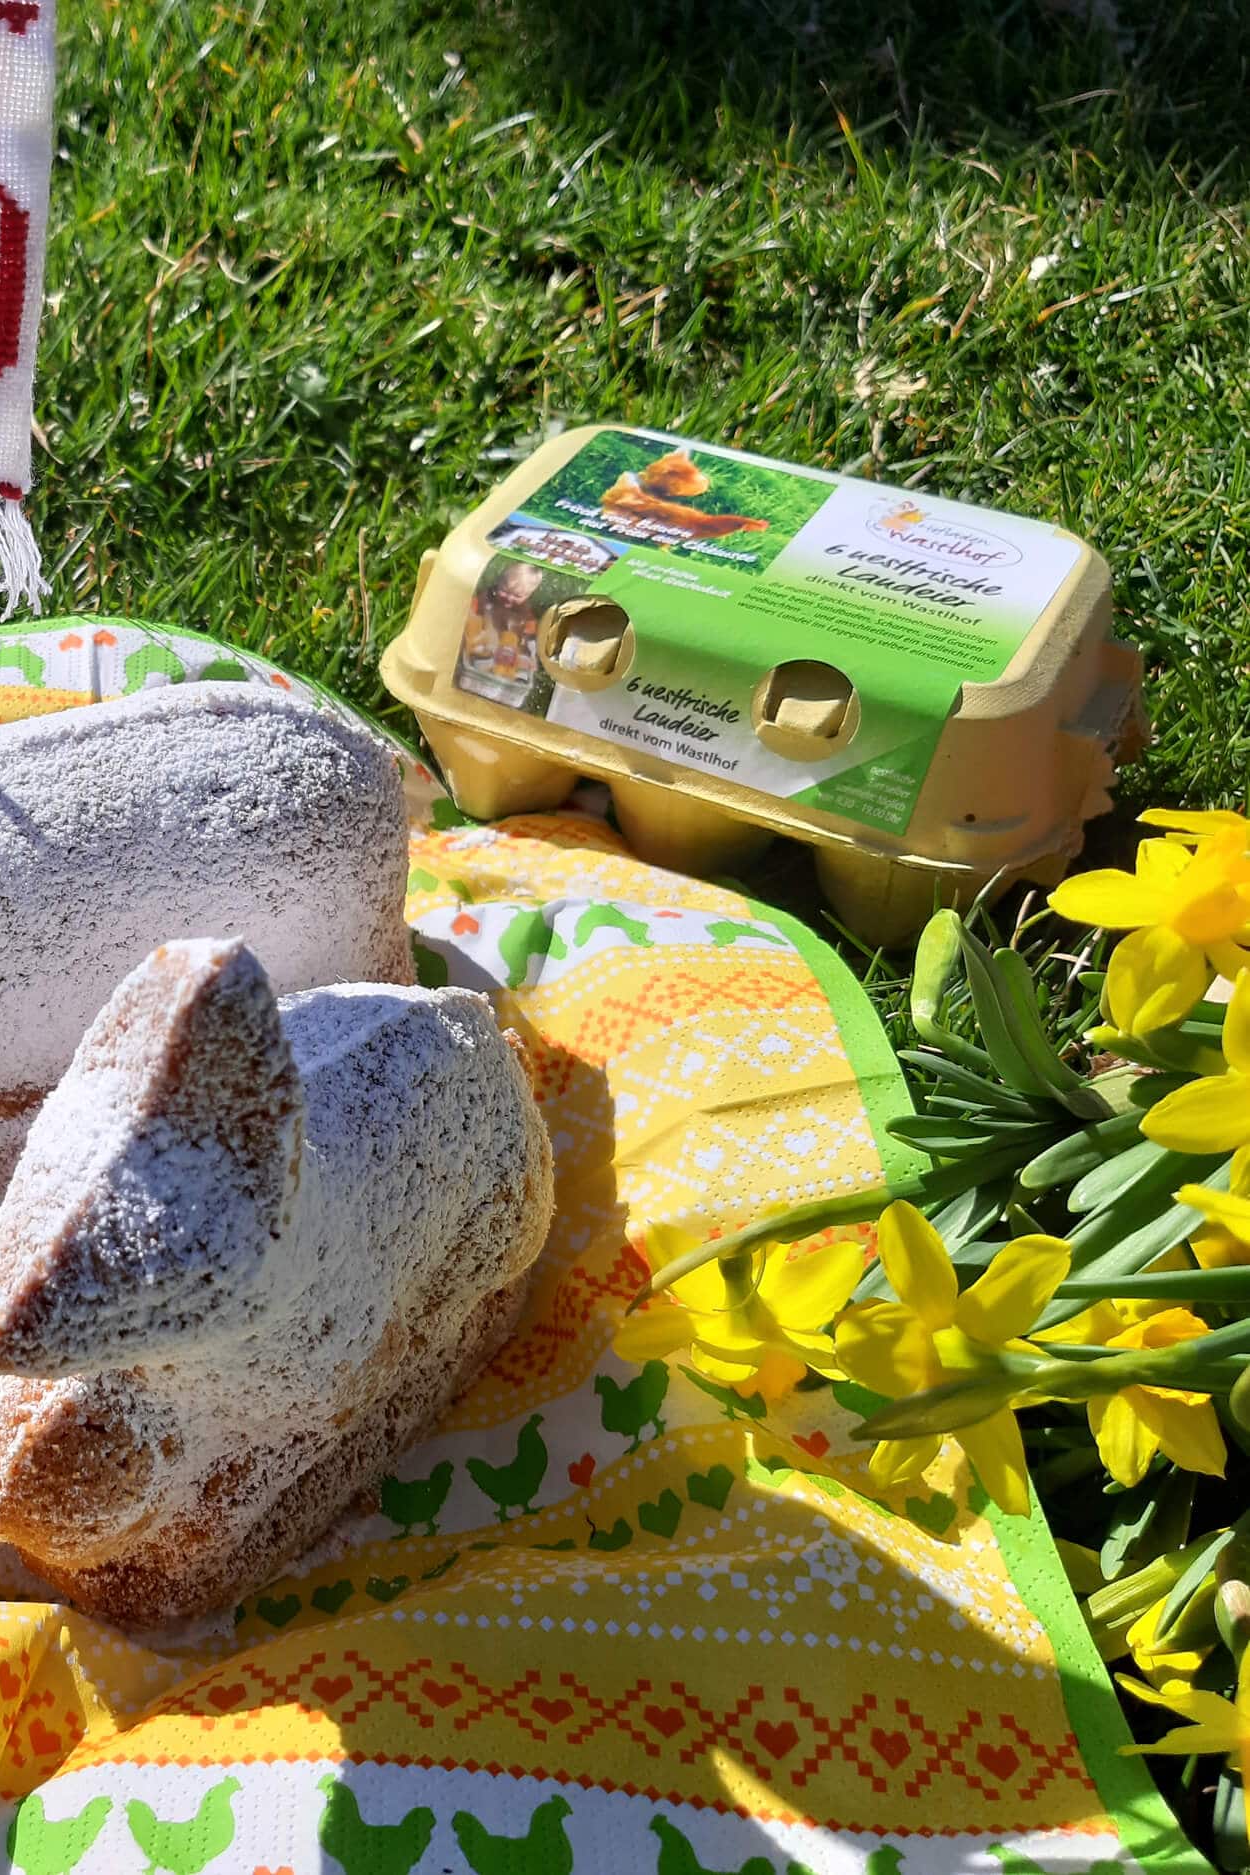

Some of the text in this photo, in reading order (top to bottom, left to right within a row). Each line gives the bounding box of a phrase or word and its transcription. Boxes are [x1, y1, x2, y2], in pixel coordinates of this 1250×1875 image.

[824, 544, 849, 555] 6
[805, 575, 983, 626] direkt vom Wastlhof
[626, 676, 642, 692] 6
[599, 717, 740, 771] direkt vom Wastlhof
